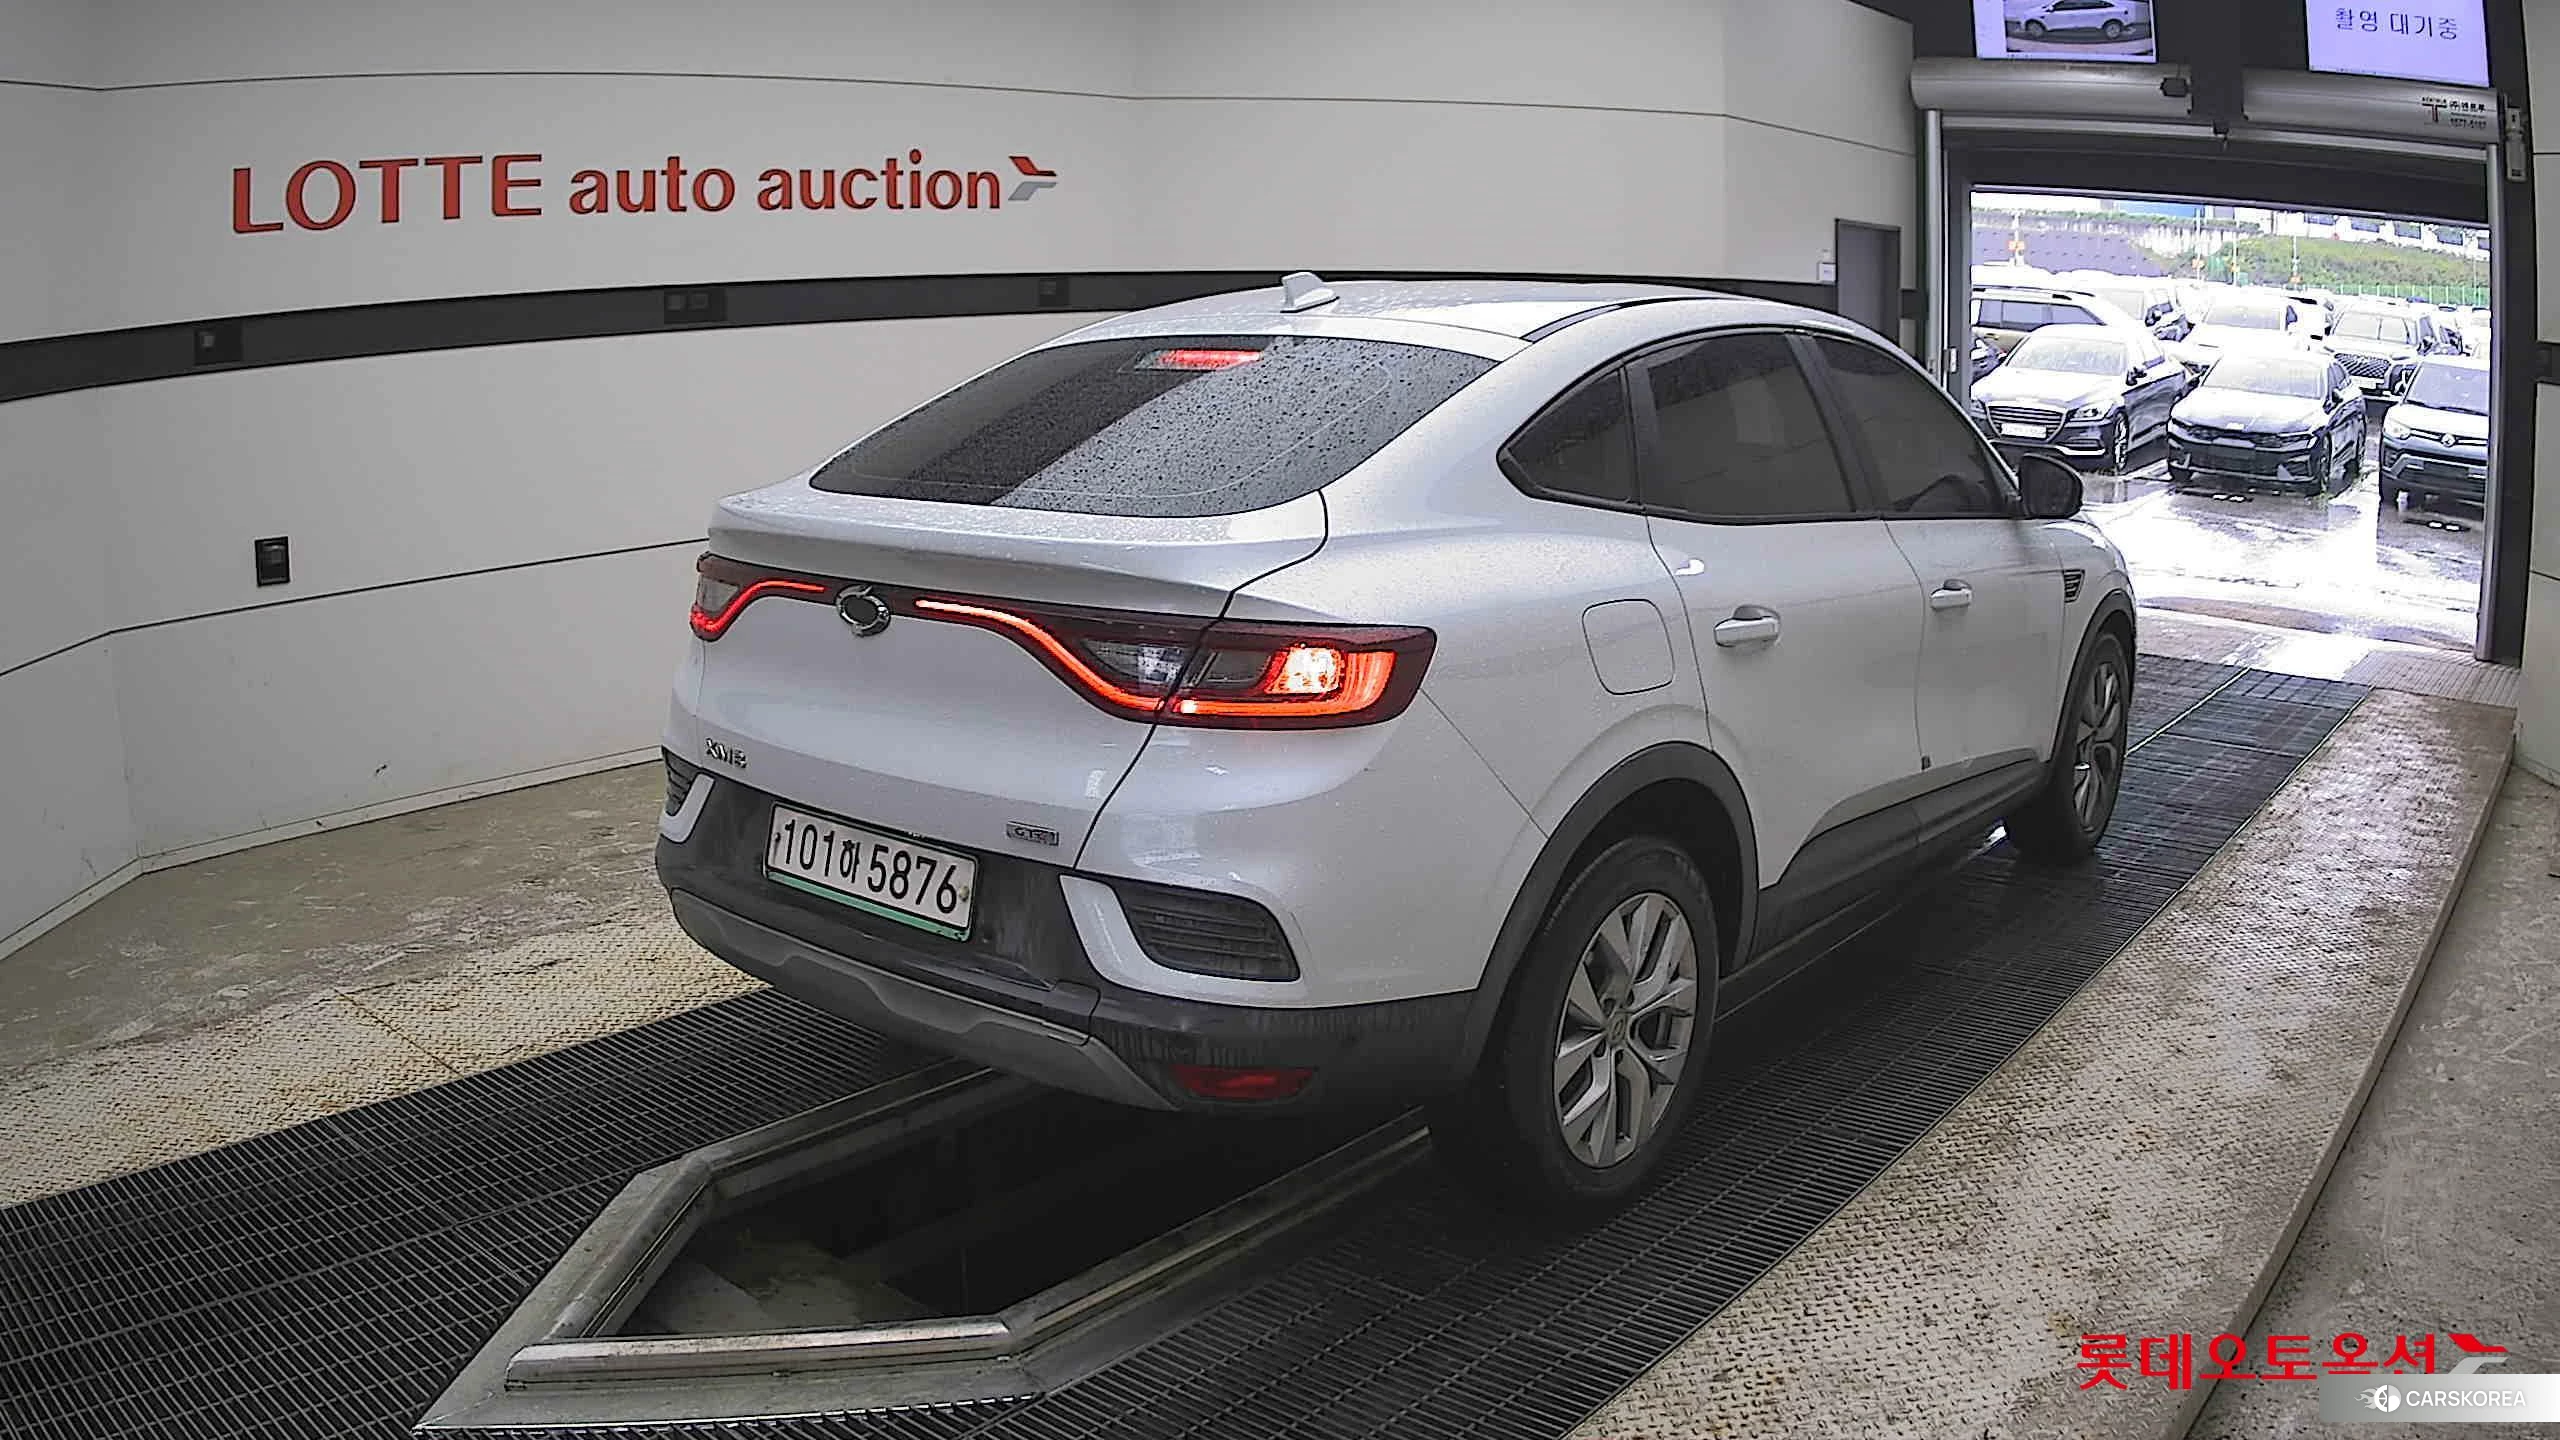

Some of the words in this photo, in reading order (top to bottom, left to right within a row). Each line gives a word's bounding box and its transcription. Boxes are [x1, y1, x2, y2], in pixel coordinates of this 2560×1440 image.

[2336, 8, 2378, 32] 촬영
[2390, 13, 2457, 40] 대기중
[233, 154, 542, 233] LOTTE
[568, 156, 736, 214] auto
[757, 148, 1001, 210] auction
[785, 819, 860, 883] 101하
[867, 844, 958, 914] 5876
